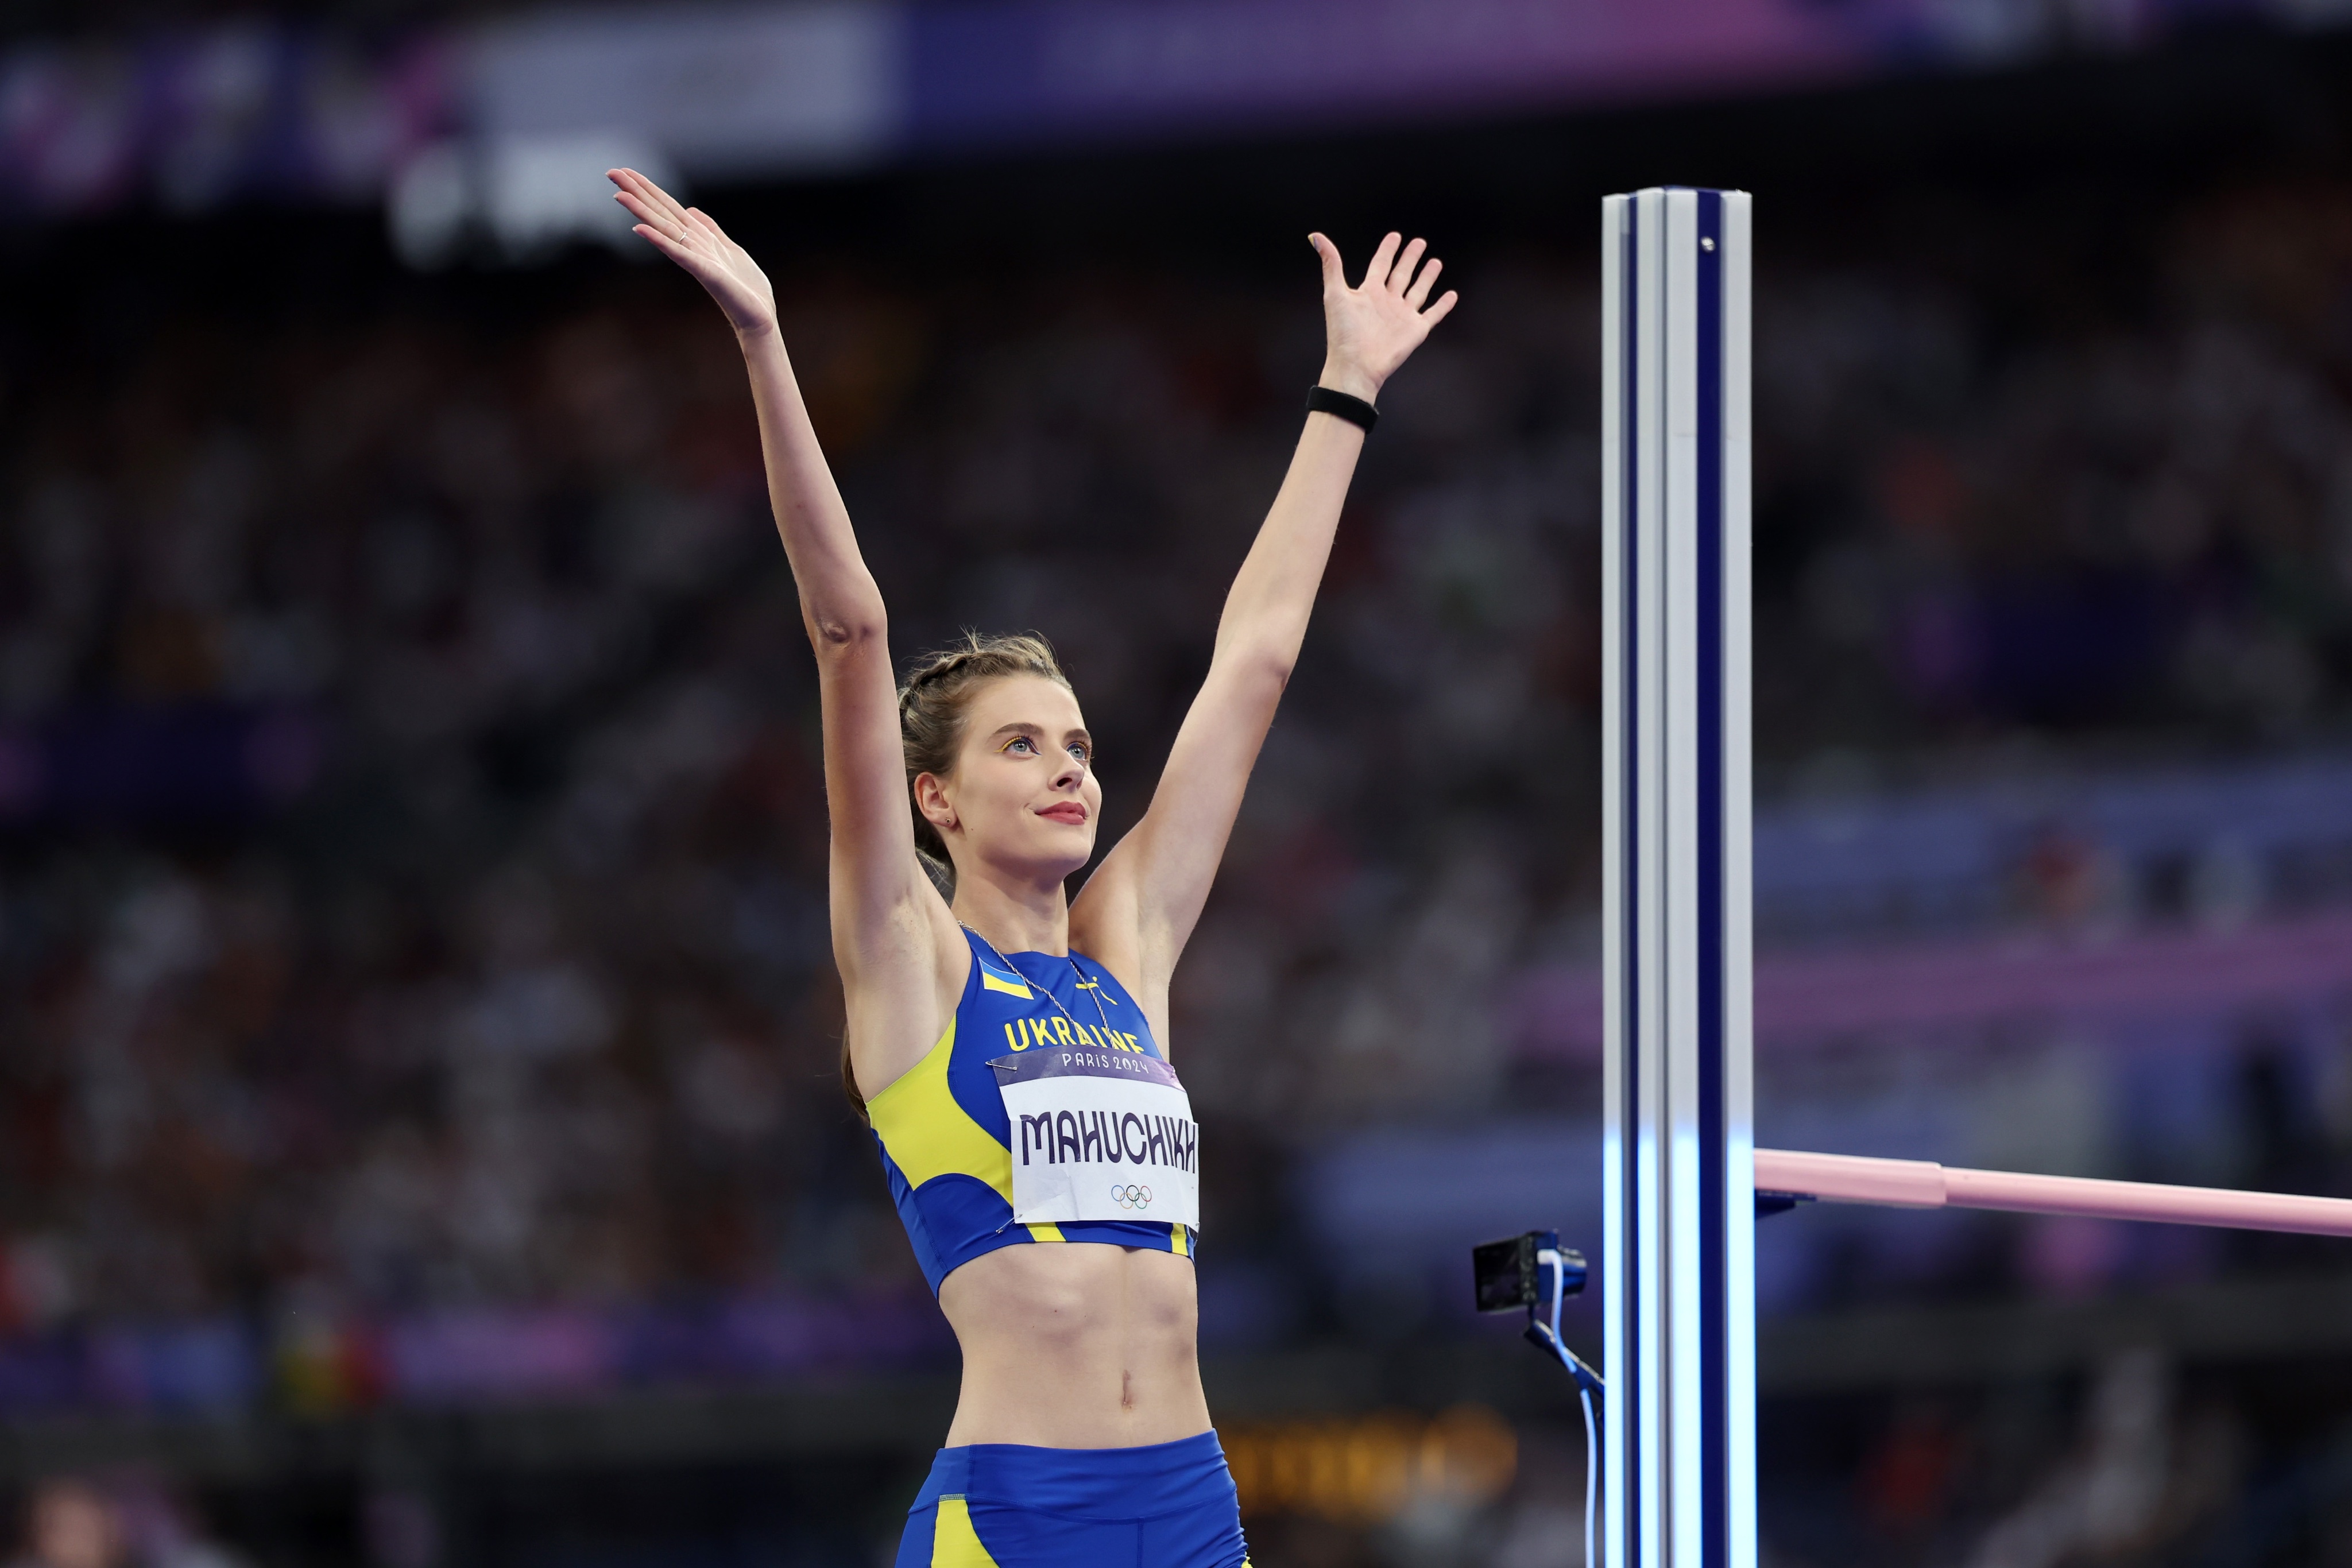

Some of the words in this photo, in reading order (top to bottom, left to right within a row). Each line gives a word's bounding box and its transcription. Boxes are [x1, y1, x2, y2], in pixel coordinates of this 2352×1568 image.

[1004, 1016, 1144, 1054] UKRAINE
[1113, 1056, 1149, 1074] 2024
[1020, 1110, 1195, 1174] MAHUCHIKH
